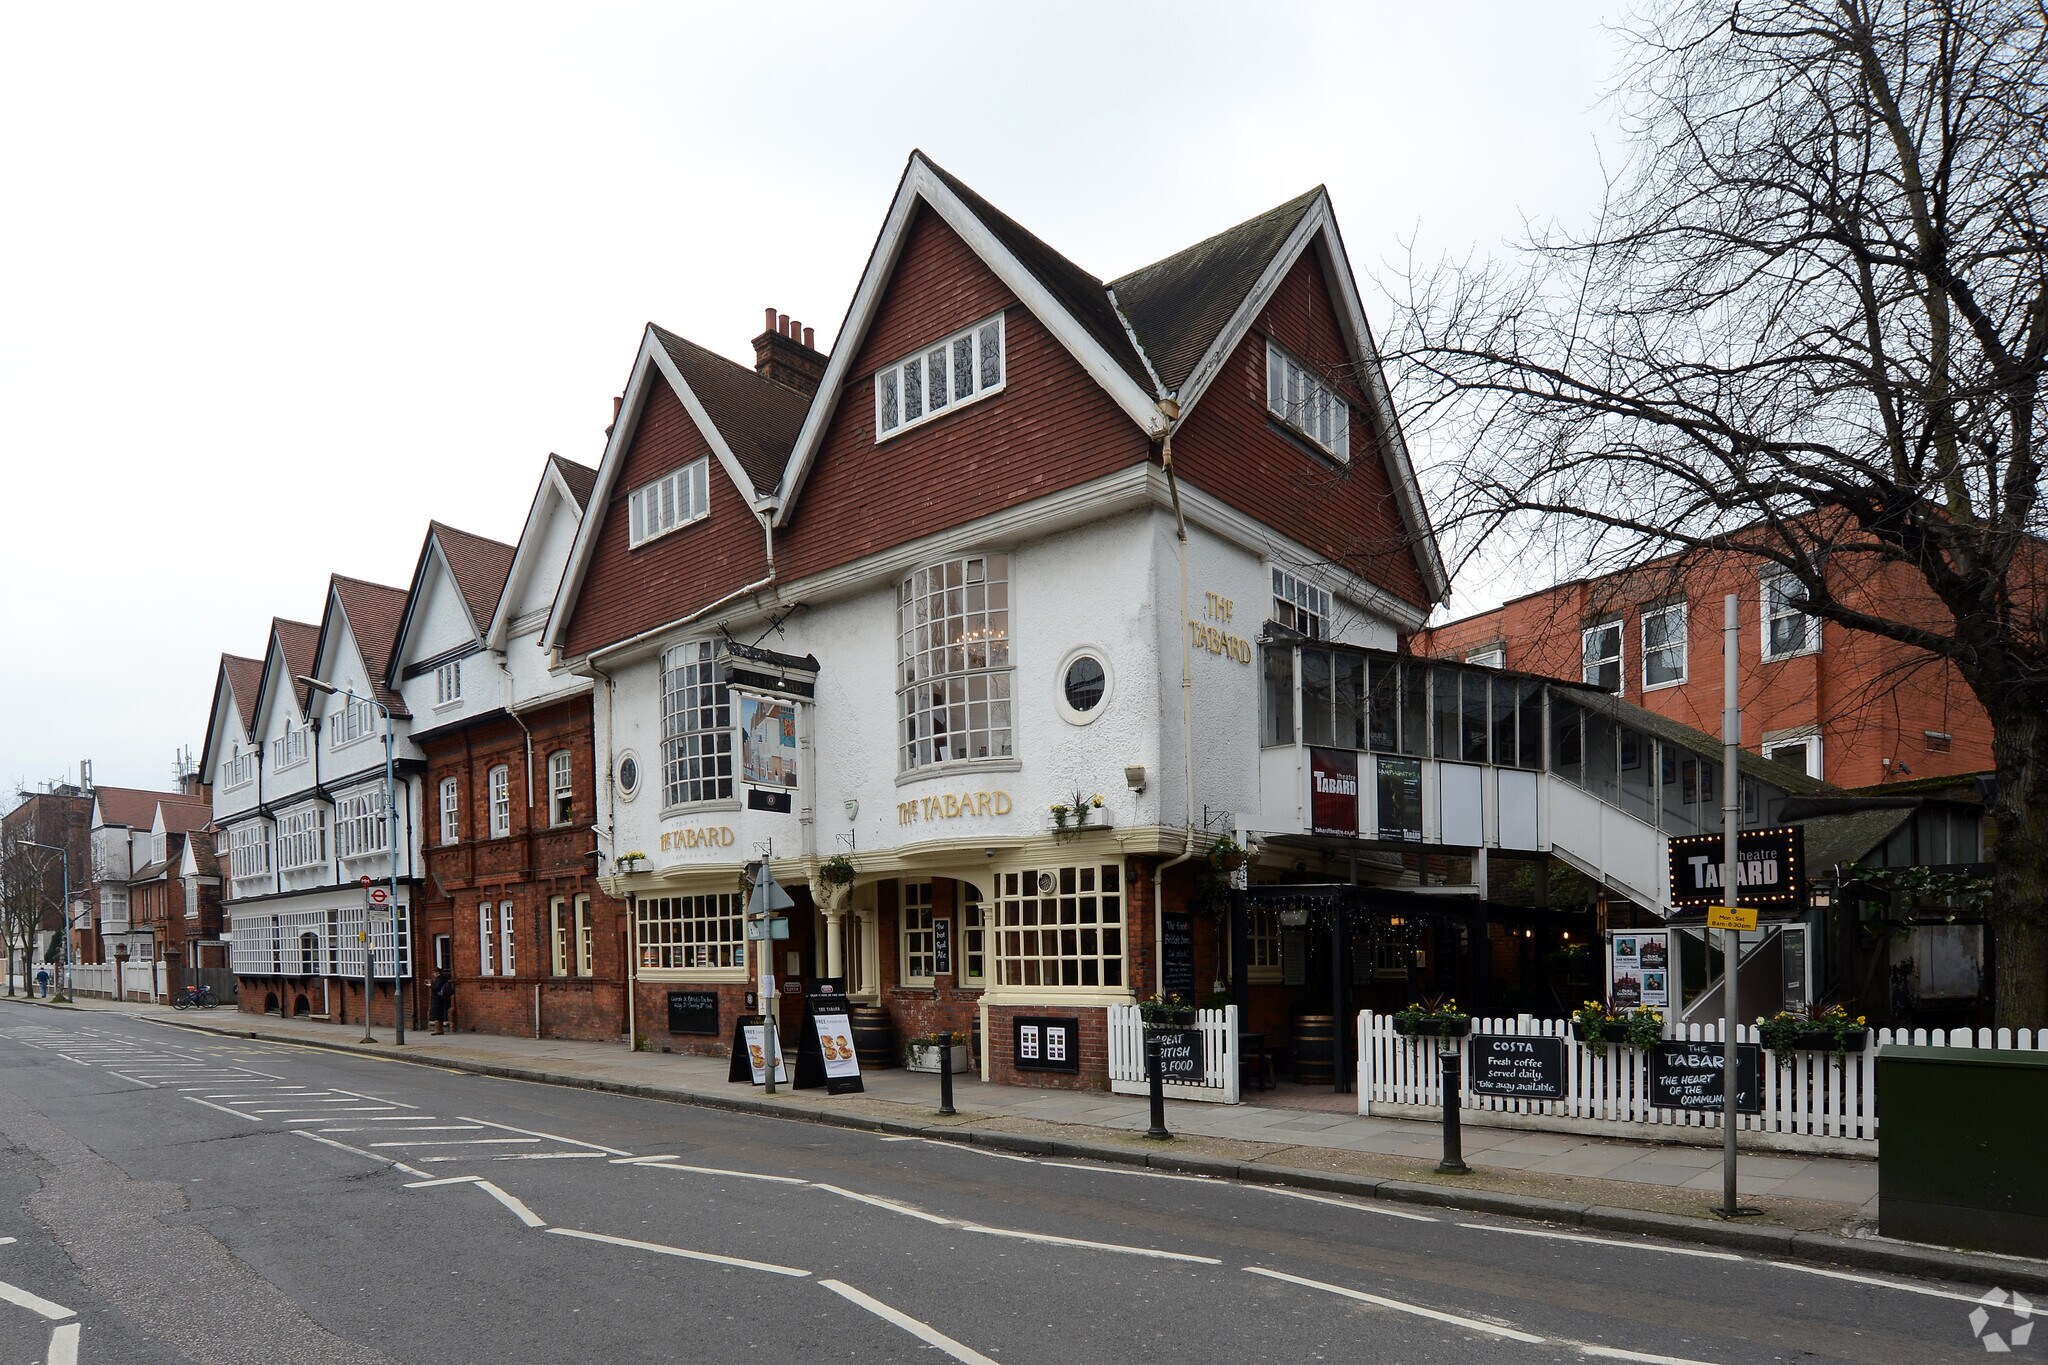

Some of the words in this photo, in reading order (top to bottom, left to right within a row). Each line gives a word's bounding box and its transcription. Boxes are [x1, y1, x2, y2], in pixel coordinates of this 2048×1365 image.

[1206, 591, 1233, 623] THE
[1189, 620, 1251, 665] TABARD
[1336, 772, 1356, 781] theatre
[1313, 771, 1356, 795] TABARD
[897, 800, 918, 826] THE
[920, 790, 1012, 821] TABARD
[671, 826, 735, 849] TABARD
[1737, 849, 1777, 860] heatre
[1160, 1046, 1190, 1058] RITISH
[1493, 1041, 1533, 1052] COSTA
[1687, 1044, 1709, 1053] THE
[1170, 1060, 1193, 1071] FOOD
[1488, 1056, 1511, 1066] Fresh
[1514, 1058, 1543, 1068] coffee
[1664, 1053, 1741, 1069] TABAR
[1488, 1068, 1516, 1078] served
[1518, 1068, 1543, 1082] daily.
[1659, 1075, 1678, 1086] THE
[1680, 1073, 1716, 1084] HEART
[1477, 1080, 1494, 1088] Take
[1495, 1082, 1515, 1092] away
[1516, 1082, 1556, 1092] available.
[1669, 1086, 1682, 1096] OF
[1684, 1085, 1703, 1094] THE
